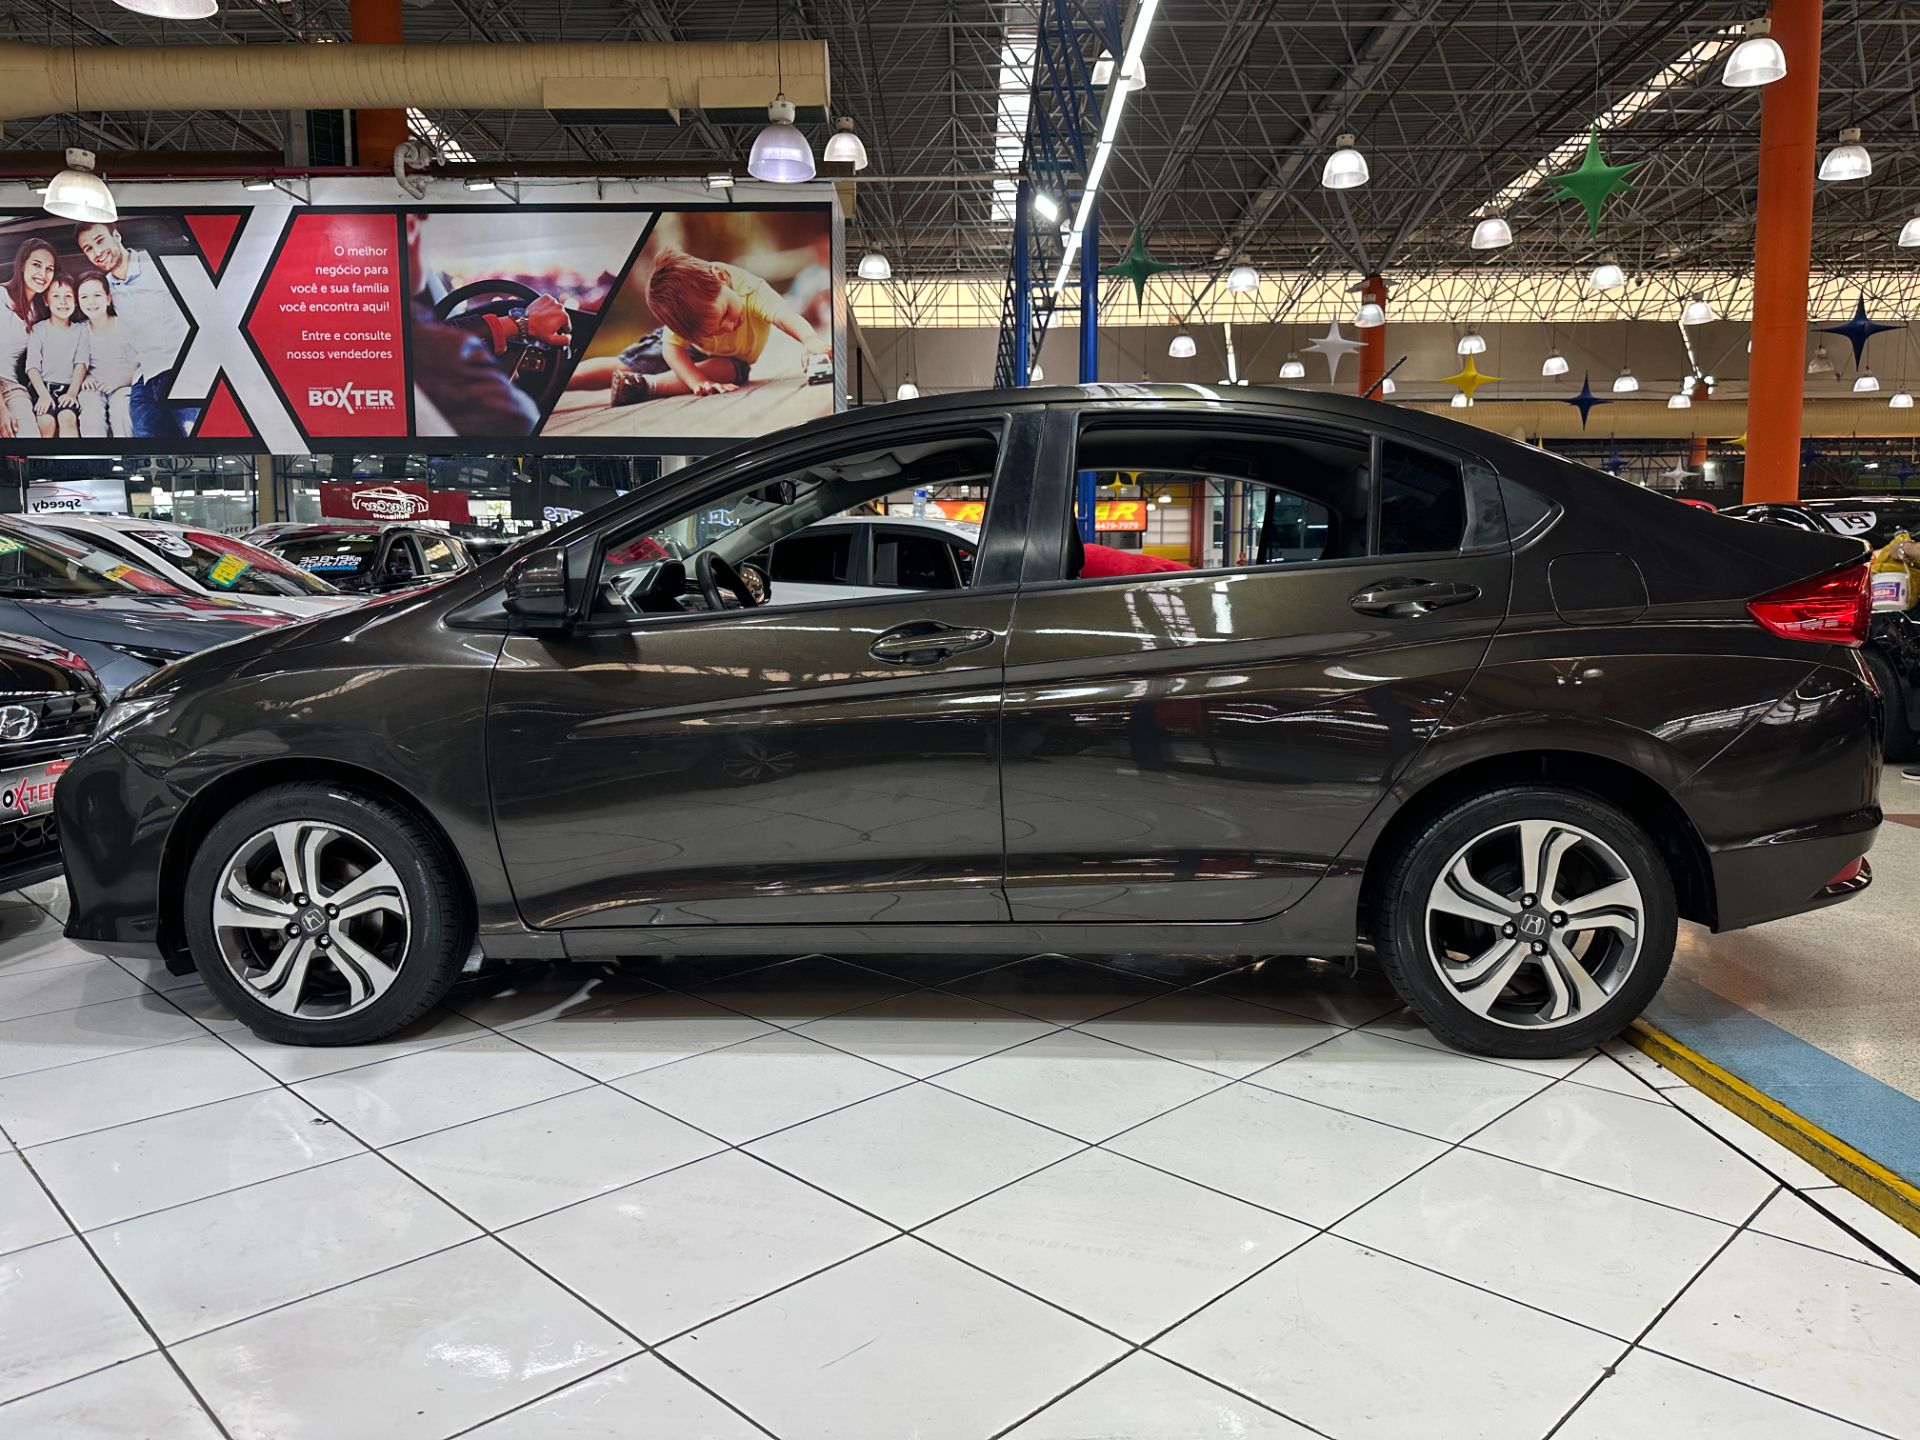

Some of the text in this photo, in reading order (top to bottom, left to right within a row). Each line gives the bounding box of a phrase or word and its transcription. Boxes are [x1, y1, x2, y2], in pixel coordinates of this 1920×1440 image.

[334, 246, 388, 256] O melhor
[315, 265, 389, 277] negócio para
[290, 283, 318, 293] você
[352, 283, 389, 293] família
[279, 302, 390, 314] você encontra aqui!
[301, 331, 331, 340] Entre
[343, 331, 392, 340] consulte
[286, 349, 392, 359] nossos vendedores
[308, 381, 395, 414] BOXTER
